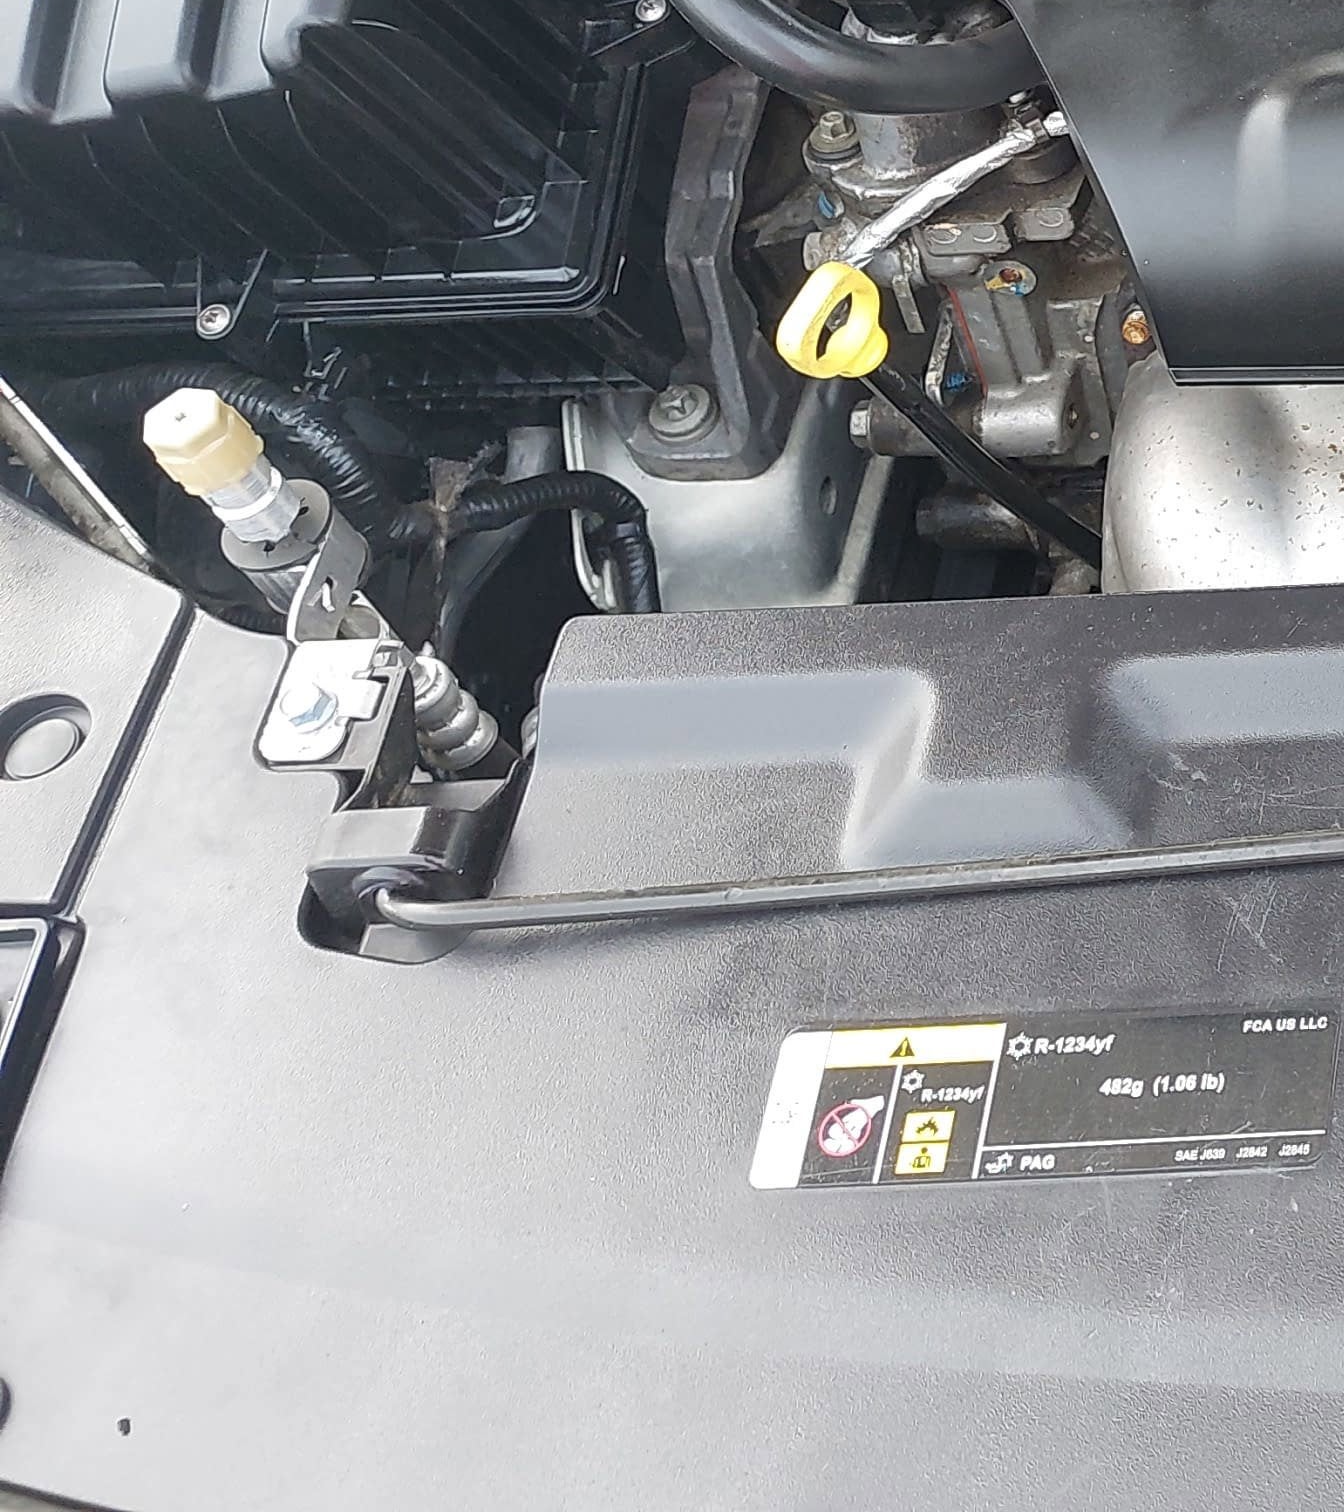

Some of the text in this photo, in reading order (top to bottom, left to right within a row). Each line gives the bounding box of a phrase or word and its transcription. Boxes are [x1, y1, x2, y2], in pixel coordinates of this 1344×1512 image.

[1243, 1016, 1328, 1033] FCA US LLC
[1034, 1033, 1116, 1055] R-1234yf
[1201, 1072, 1225, 1094] lb)
[921, 1084, 985, 1104] R-1234yf
[1020, 1155, 1056, 1171] PAG
[1175, 1149, 1198, 1162] SAE
